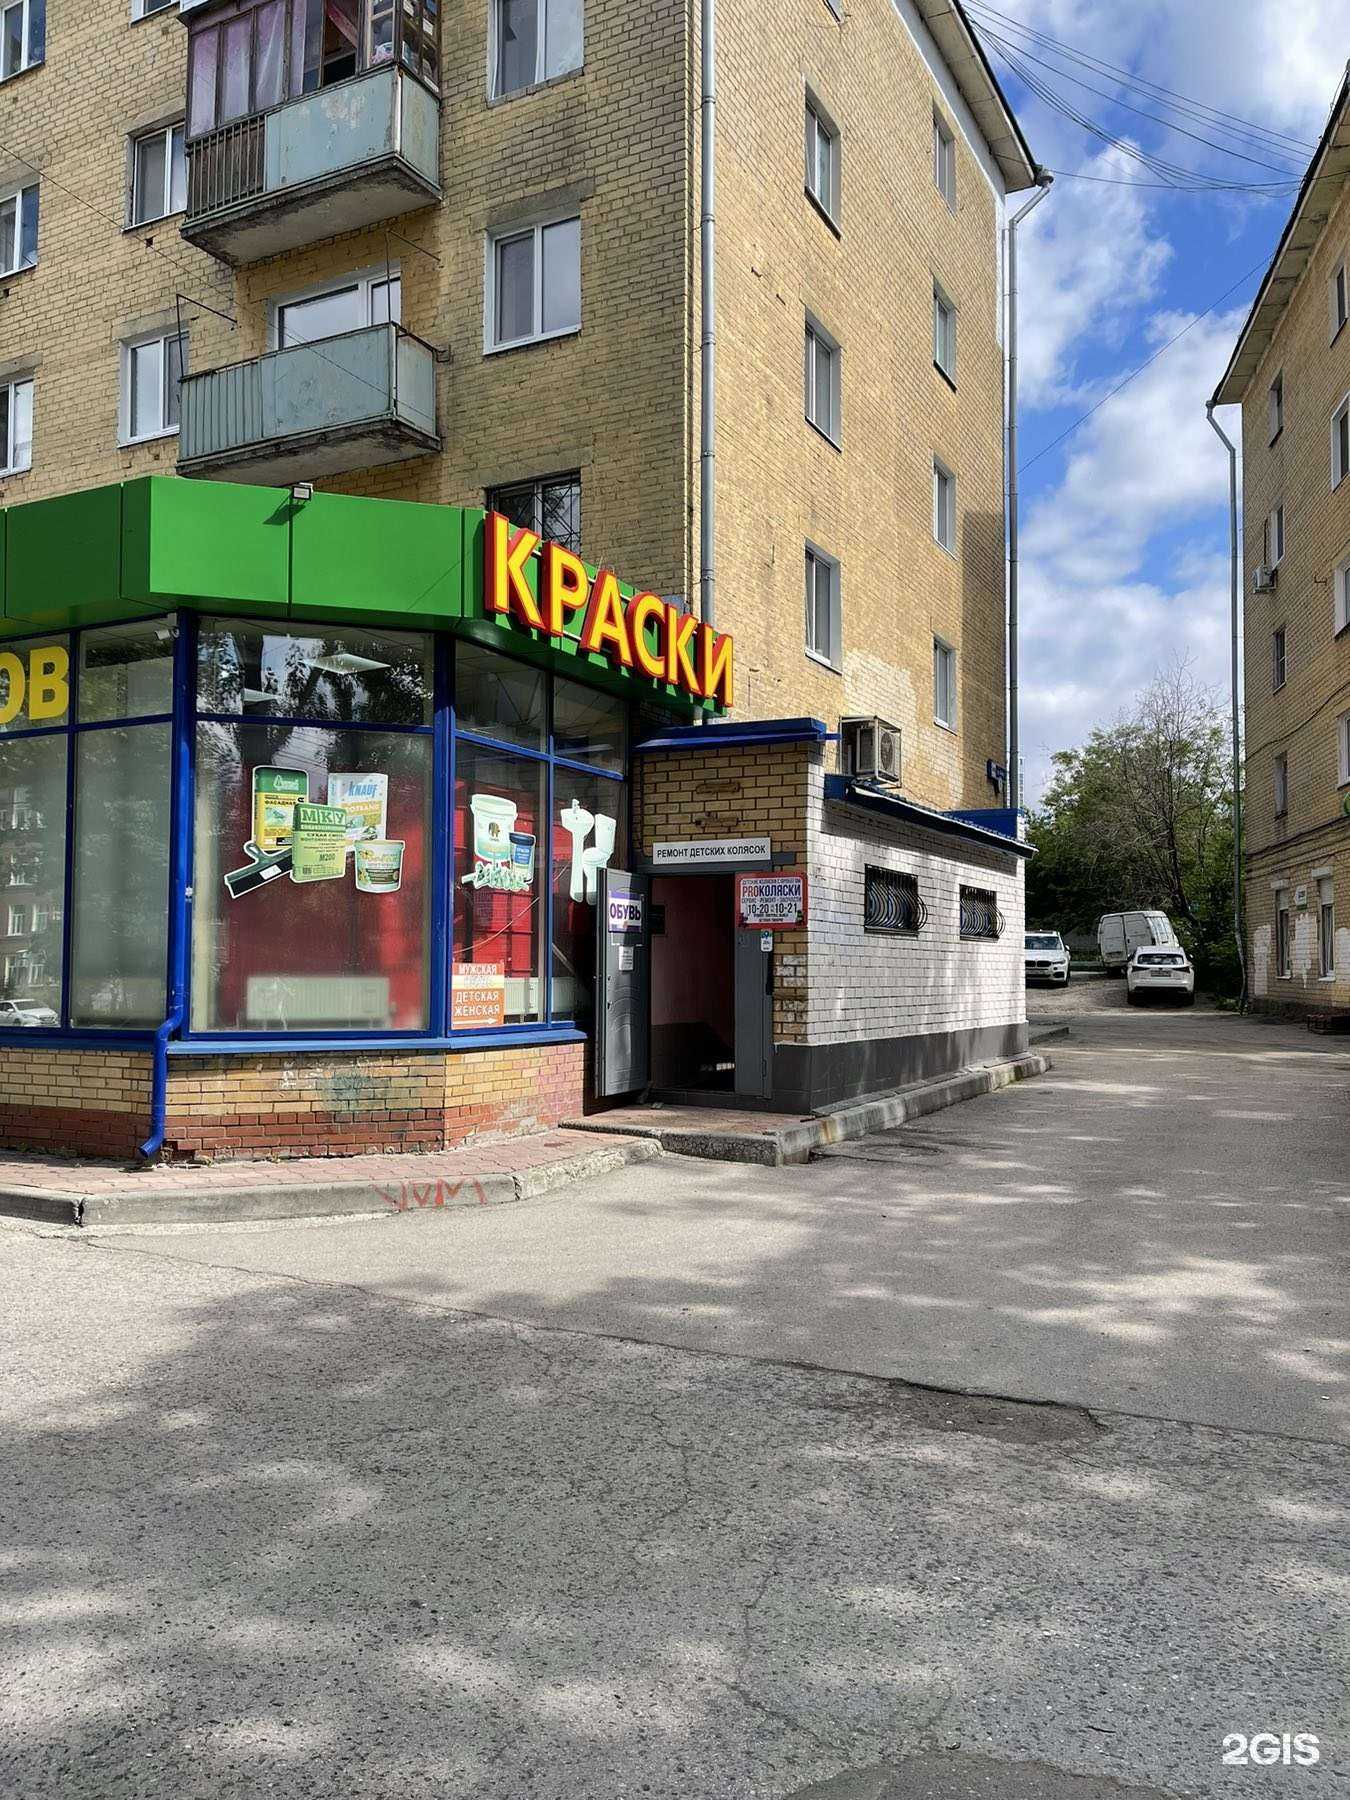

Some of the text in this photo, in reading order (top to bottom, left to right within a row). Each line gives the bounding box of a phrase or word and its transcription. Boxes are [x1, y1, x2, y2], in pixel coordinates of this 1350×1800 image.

[484, 511, 734, 707] КРАСКИ
[302, 808, 345, 824] МКУ
[657, 845, 766, 858] РЕМОНТ ДЕТСКИХ КОЛЯСОК
[609, 902, 641, 920] ОБУВЬ
[748, 903, 769, 914] 10-20
[775, 902, 797, 914] 10-21
[458, 963, 497, 975] МУЖСКАЯ
[456, 991, 499, 1004] ДЕТСКАЯ
[454, 1004, 500, 1017] ЖЕНСКАЯ
